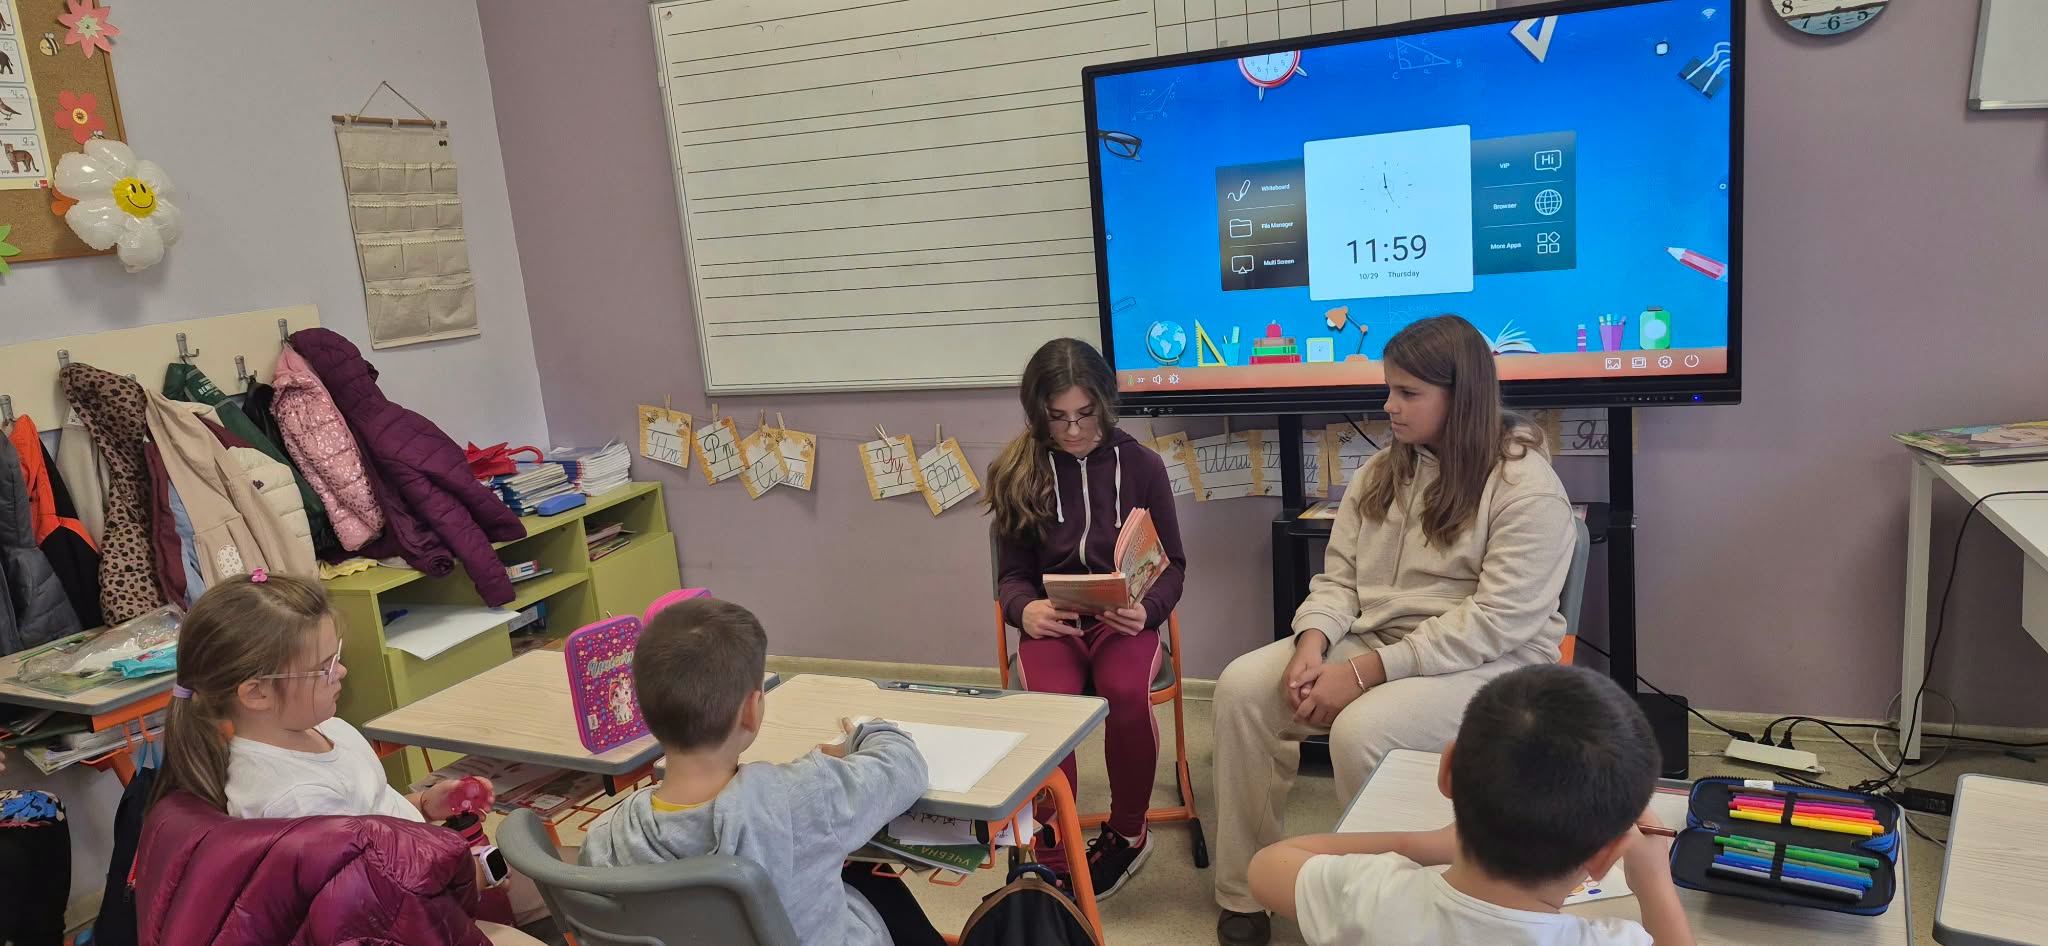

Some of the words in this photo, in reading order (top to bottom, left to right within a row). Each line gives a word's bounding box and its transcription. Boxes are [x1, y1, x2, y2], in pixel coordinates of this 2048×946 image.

[1781, 0, 1794, 14] 8
[1800, 16, 1812, 29] 7
[1827, 16, 1841, 30] 6
[1541, 154, 1554, 165] Hi
[1261, 184, 1290, 192] Whiteboard
[1271, 221, 1293, 229] Manager
[1346, 234, 1427, 264] 11:59
[1506, 242, 1522, 250] Apps
[1359, 272, 1378, 280] 10/29
[1388, 270, 1420, 279] Thursday
[921, 845, 972, 867] УЧЕБНА
